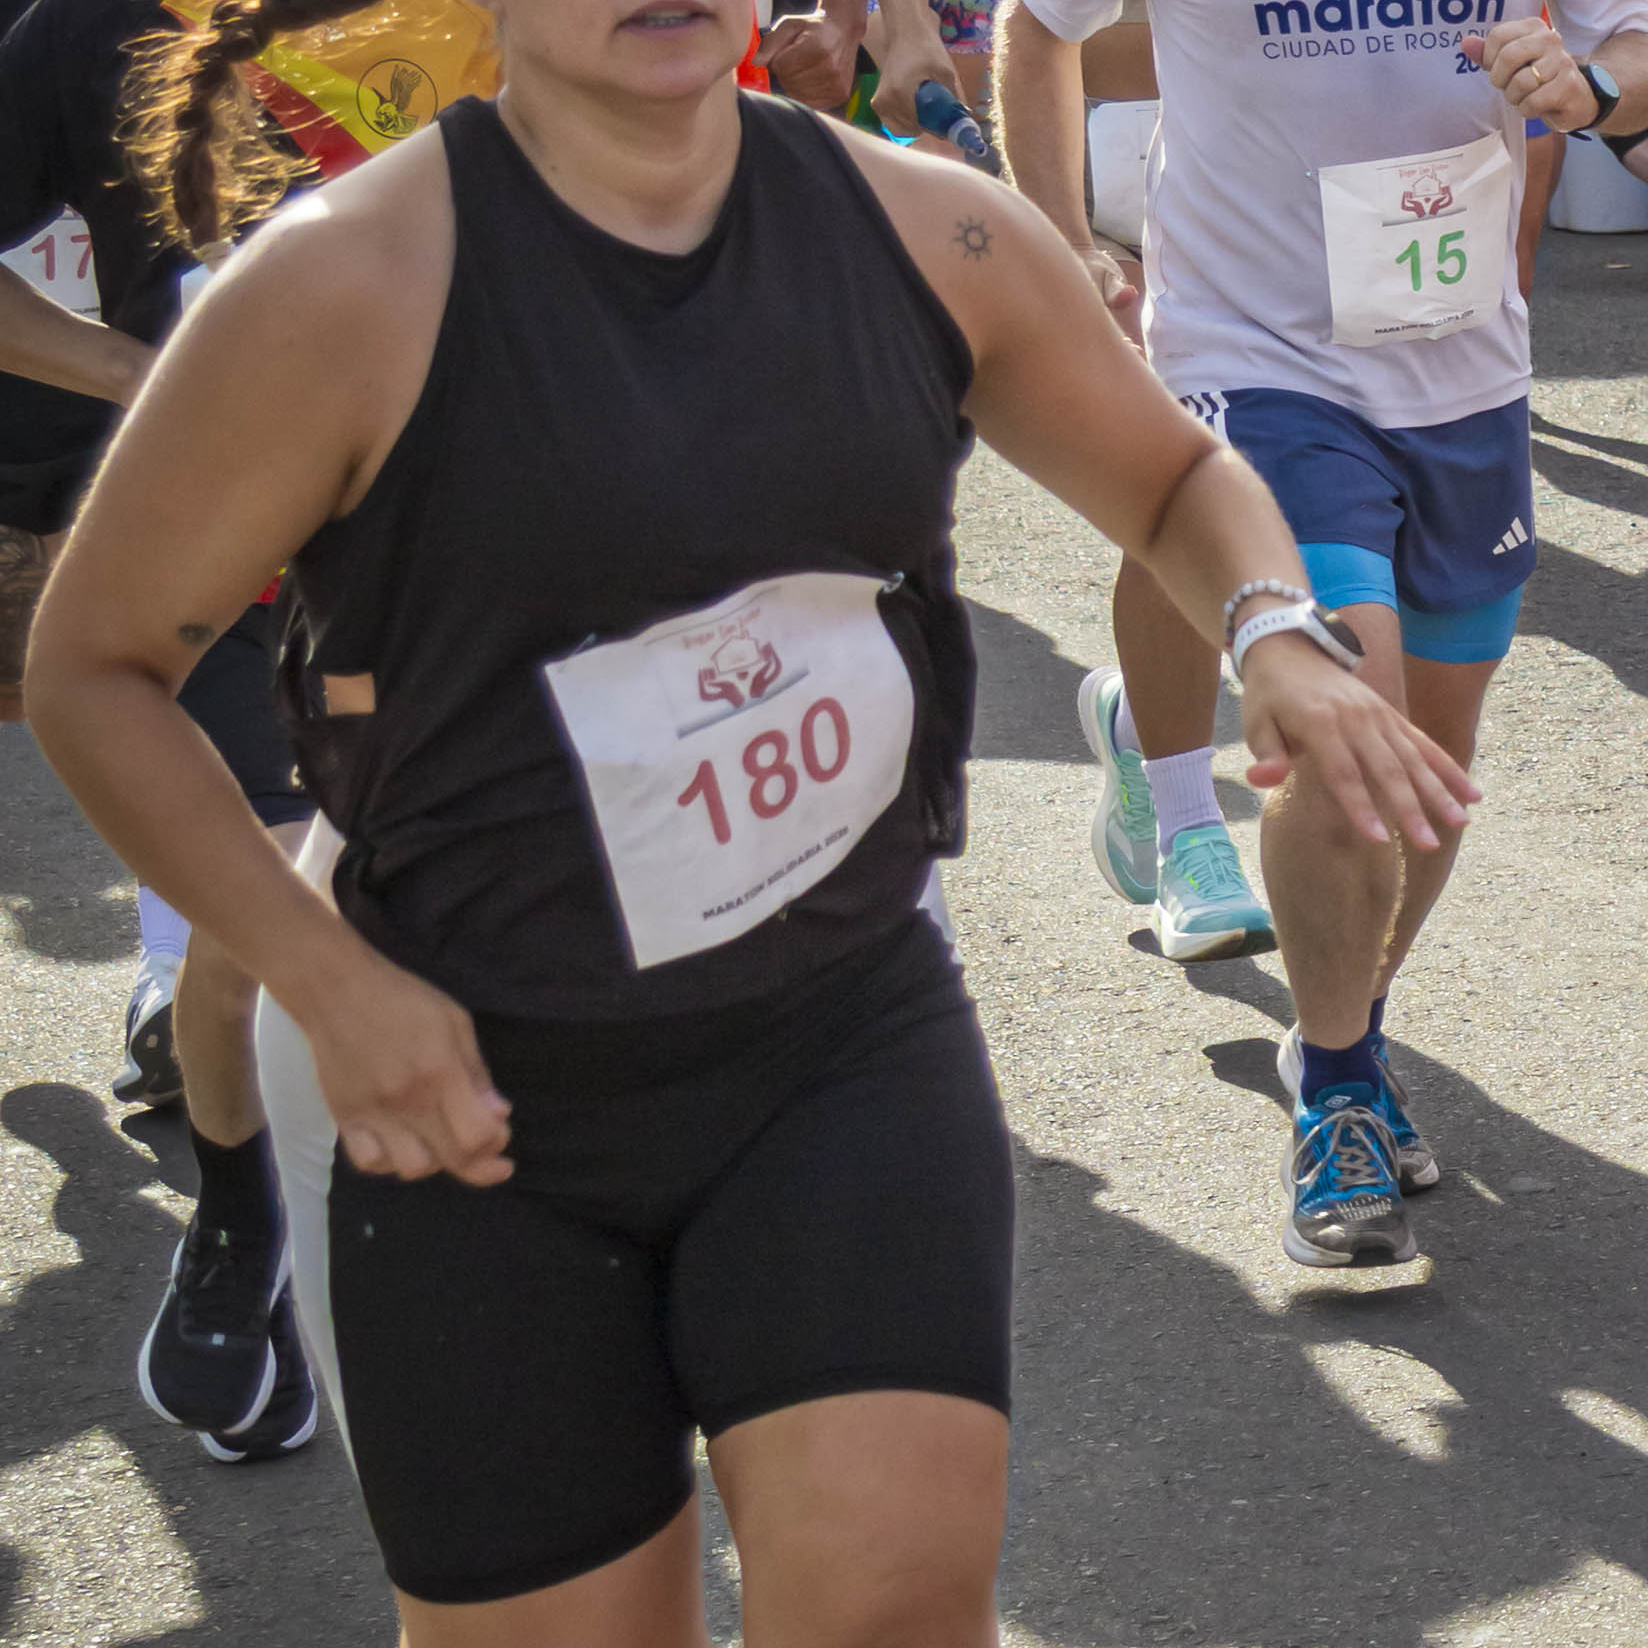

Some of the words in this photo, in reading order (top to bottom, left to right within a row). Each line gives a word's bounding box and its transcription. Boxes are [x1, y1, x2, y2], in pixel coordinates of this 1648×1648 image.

[1262, 38, 1356, 60] CIUDAD
[1366, 35, 1395, 53] DE
[1405, 29, 1491, 50] ROSA
[1395, 230, 1467, 292] 15
[677, 697, 852, 845] 180
